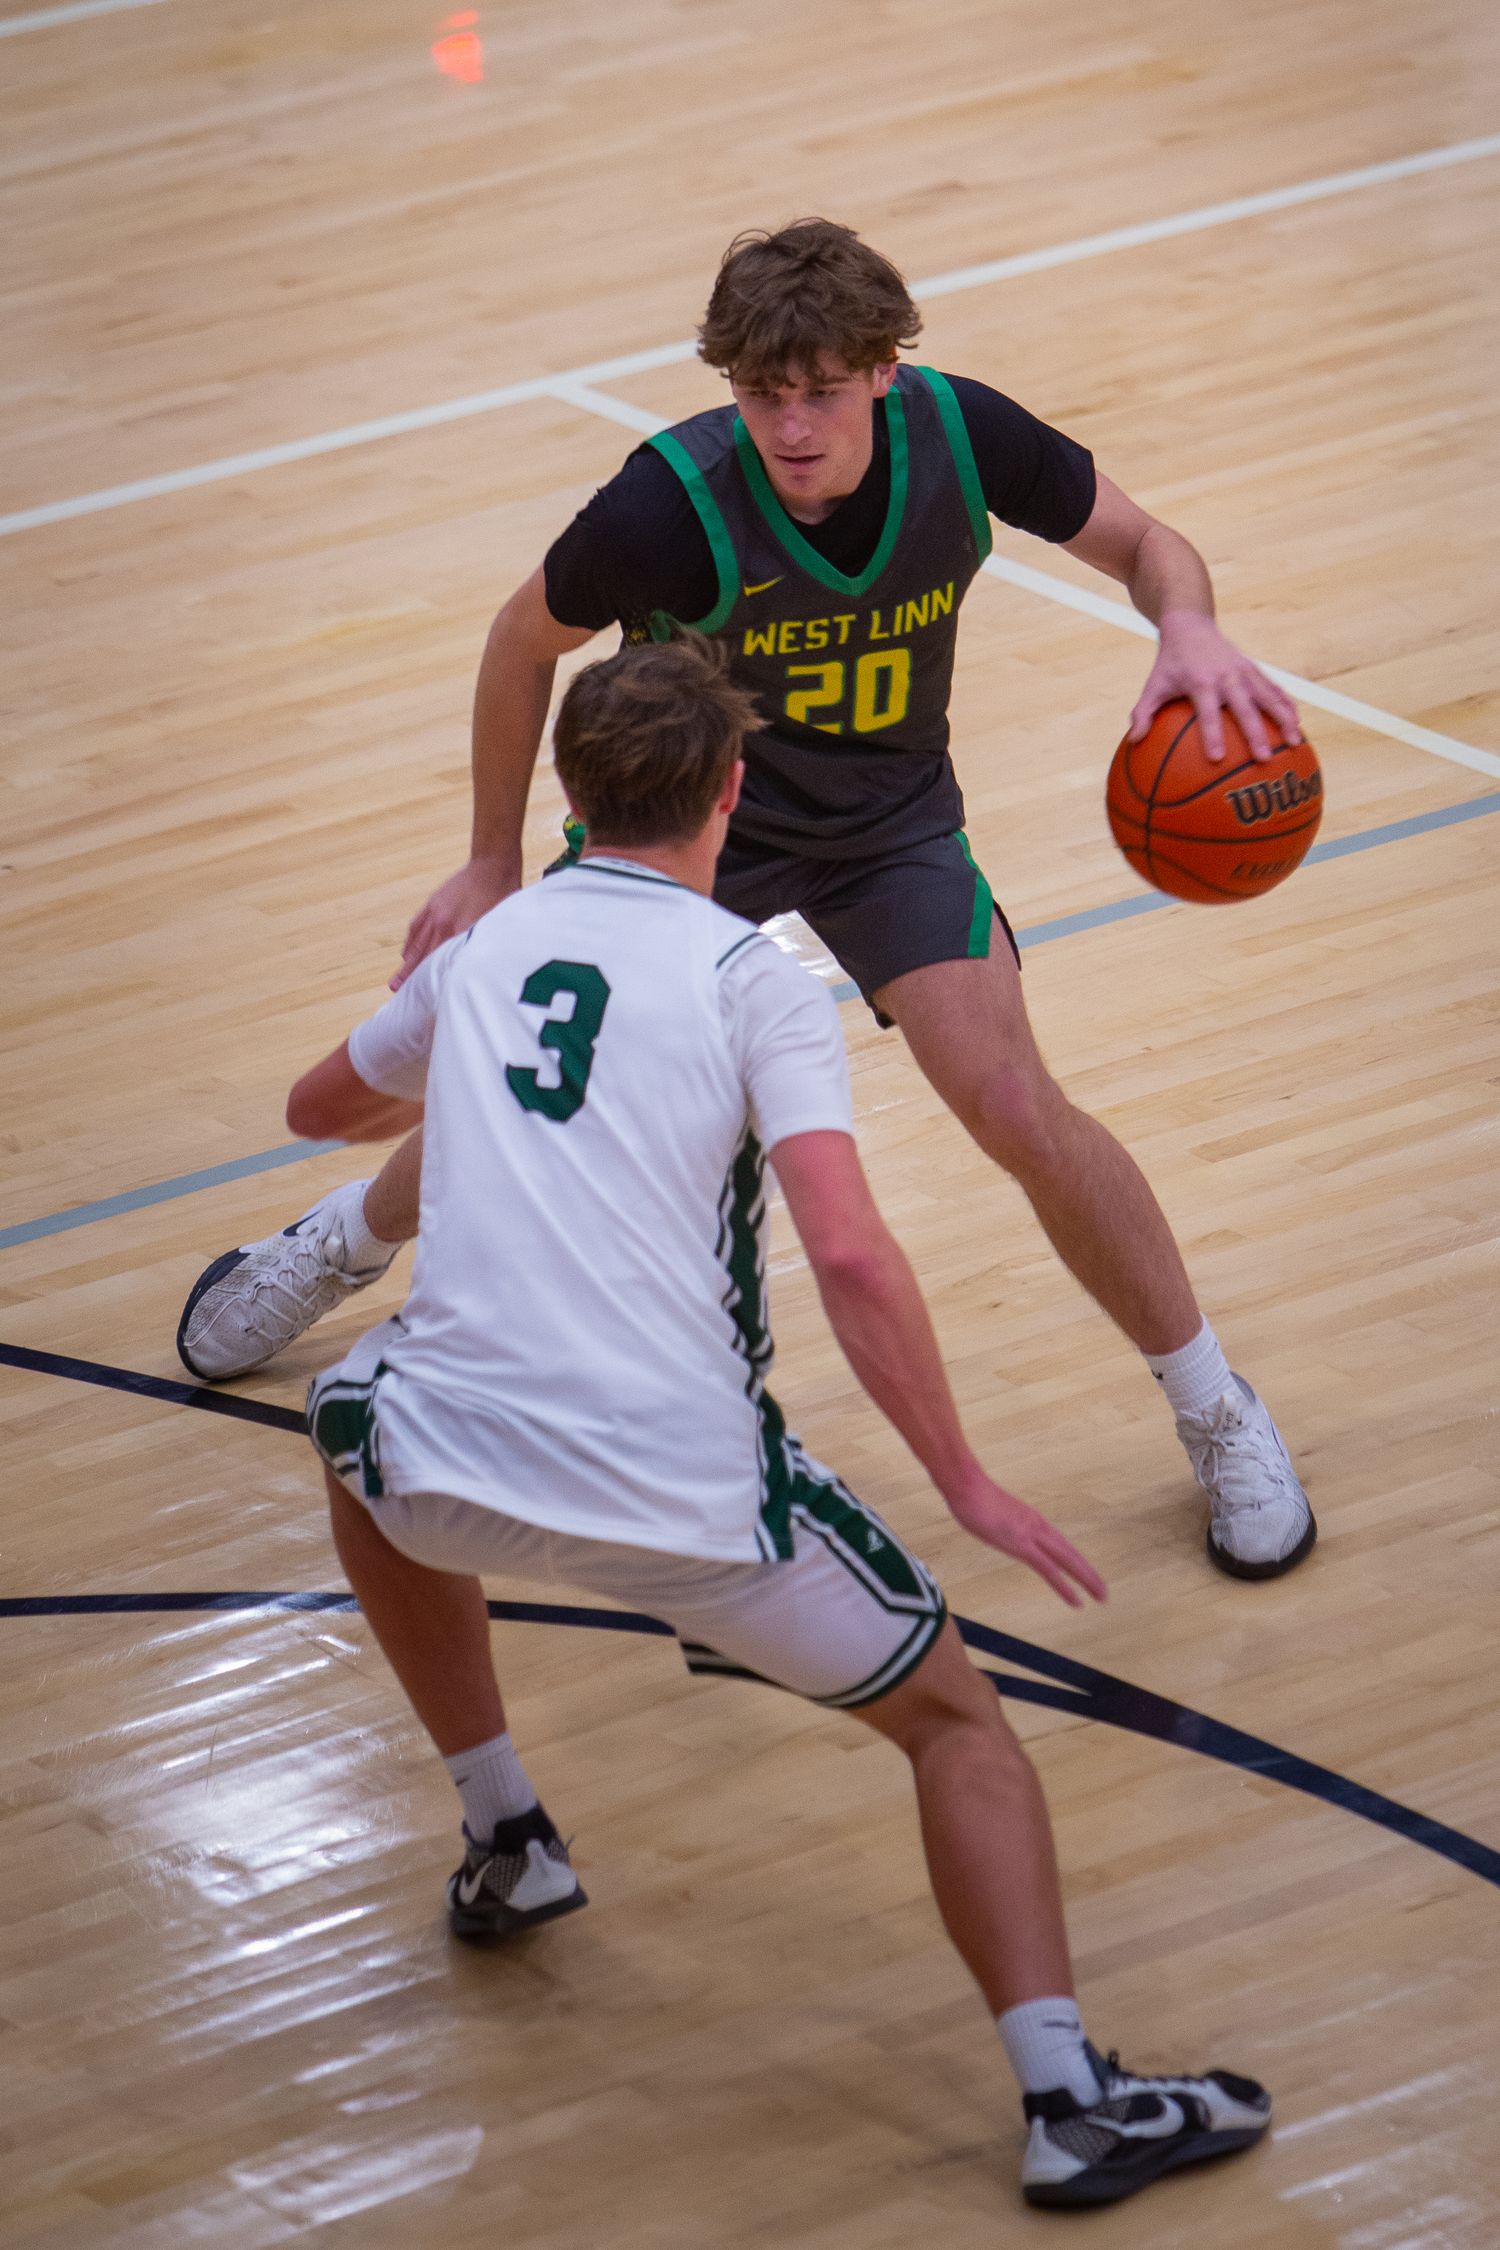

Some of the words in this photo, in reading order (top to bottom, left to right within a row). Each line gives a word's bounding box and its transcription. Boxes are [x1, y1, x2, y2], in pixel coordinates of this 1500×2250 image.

[743, 614, 856, 656] WEST
[869, 581, 954, 640] LINN
[784, 648, 910, 735] 20
[505, 959, 611, 1124] 3
